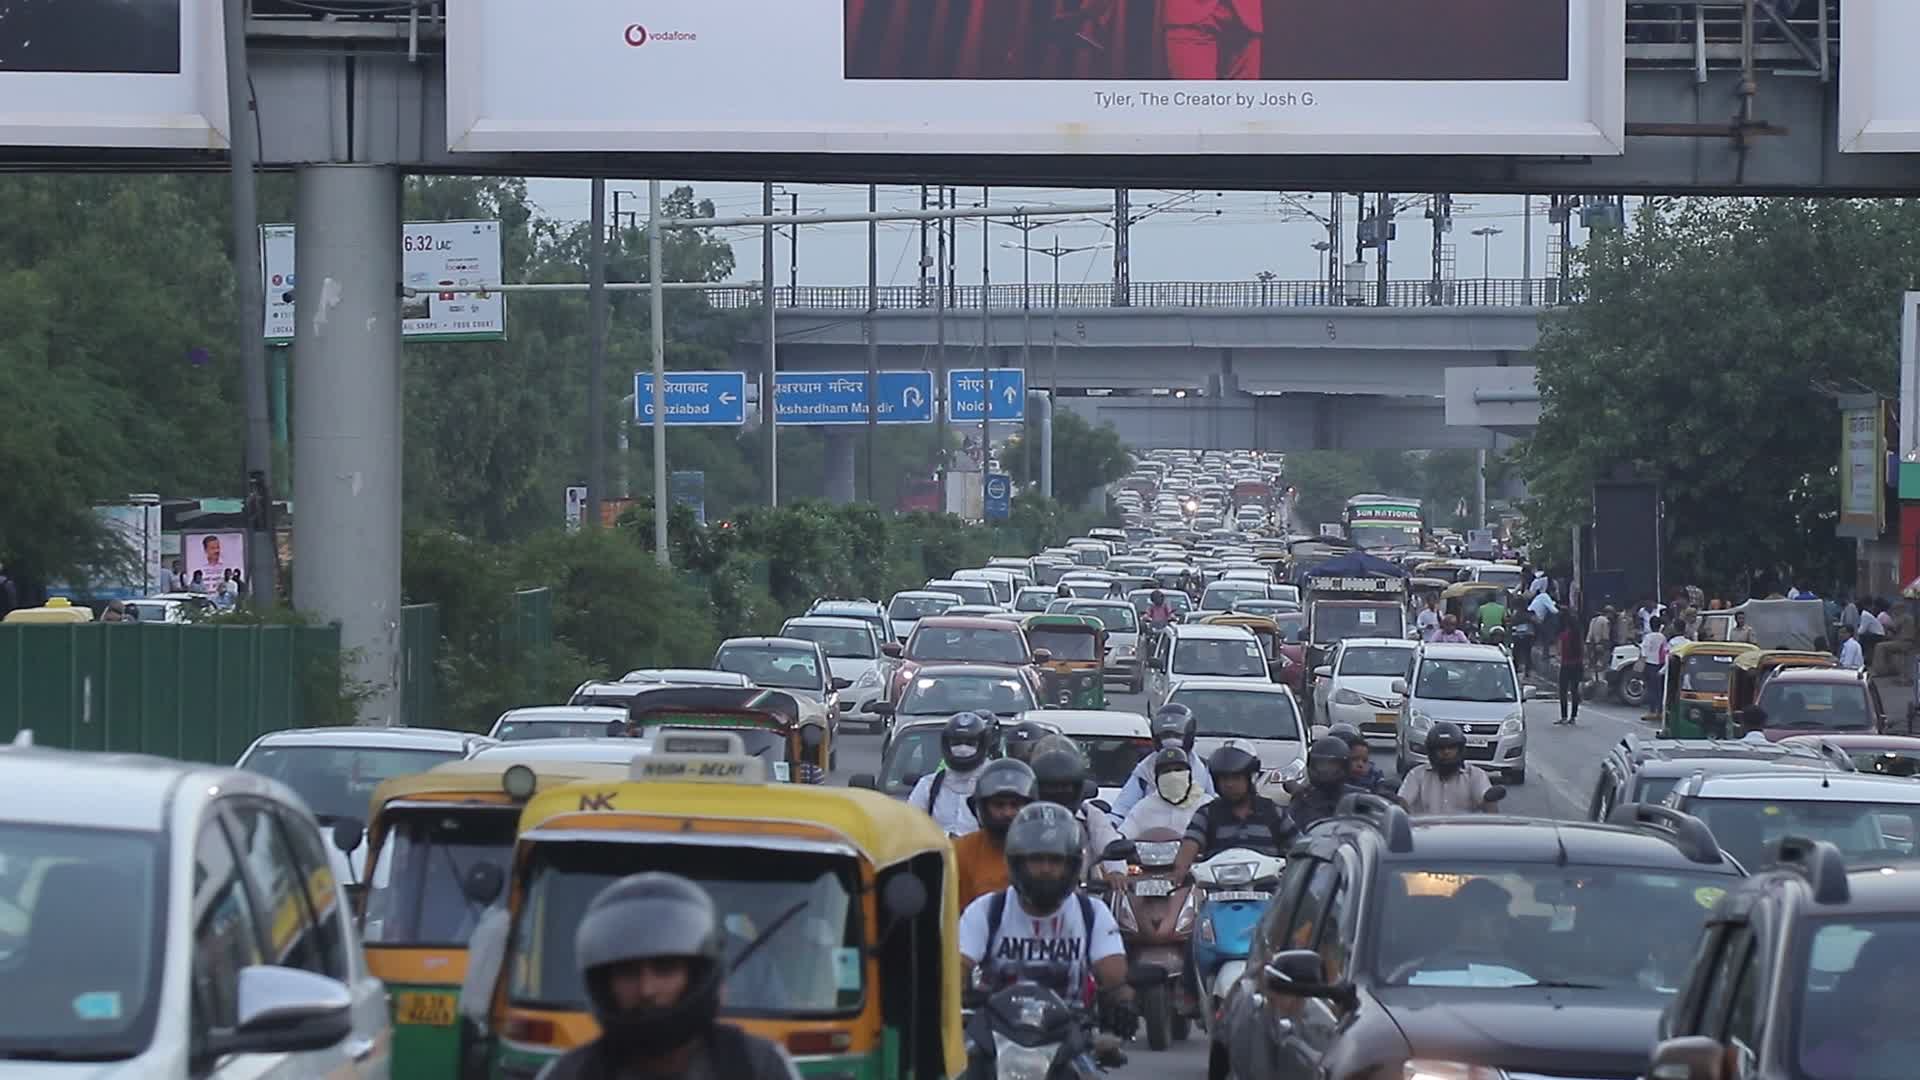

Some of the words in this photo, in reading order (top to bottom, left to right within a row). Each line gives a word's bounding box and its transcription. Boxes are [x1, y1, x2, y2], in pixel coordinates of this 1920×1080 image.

[649, 31, 697, 41] vodafone
[1094, 92, 1135, 108] Tyler,
[1140, 92, 1169, 106] The
[1174, 92, 1231, 106] Creator
[1236, 92, 1255, 108] by
[1259, 92, 1296, 106] Josh
[1301, 92, 1318, 106] G.
[405, 235, 433, 251] 6.32
[644, 403, 710, 415] Gaziabad
[851, 402, 895, 414] Madir
[1374, 509, 1418, 519] NATIONAL
[698, 762, 745, 777] DELHI
[579, 791, 620, 811] NK
